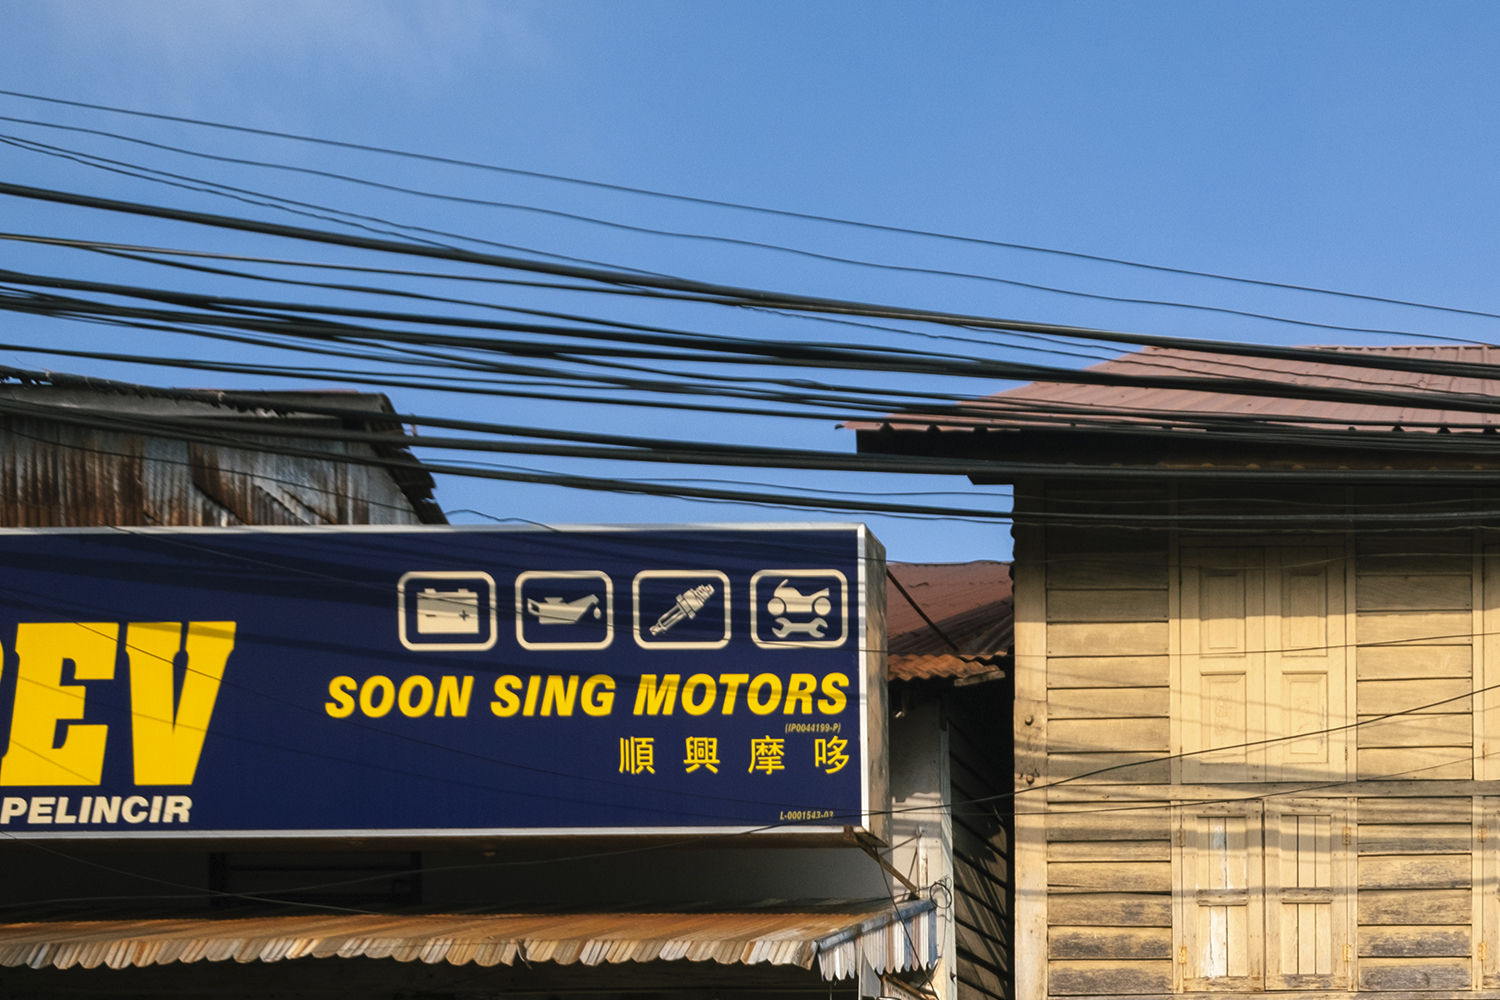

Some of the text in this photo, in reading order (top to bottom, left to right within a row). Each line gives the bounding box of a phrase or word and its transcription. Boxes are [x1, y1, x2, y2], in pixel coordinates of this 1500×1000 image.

[0, 621, 237, 786] EV
[325, 673, 850, 719] SOON SING MOTORS
[618, 735, 850, 775] 順興摩哆
[0, 796, 193, 824] PELINCIR
